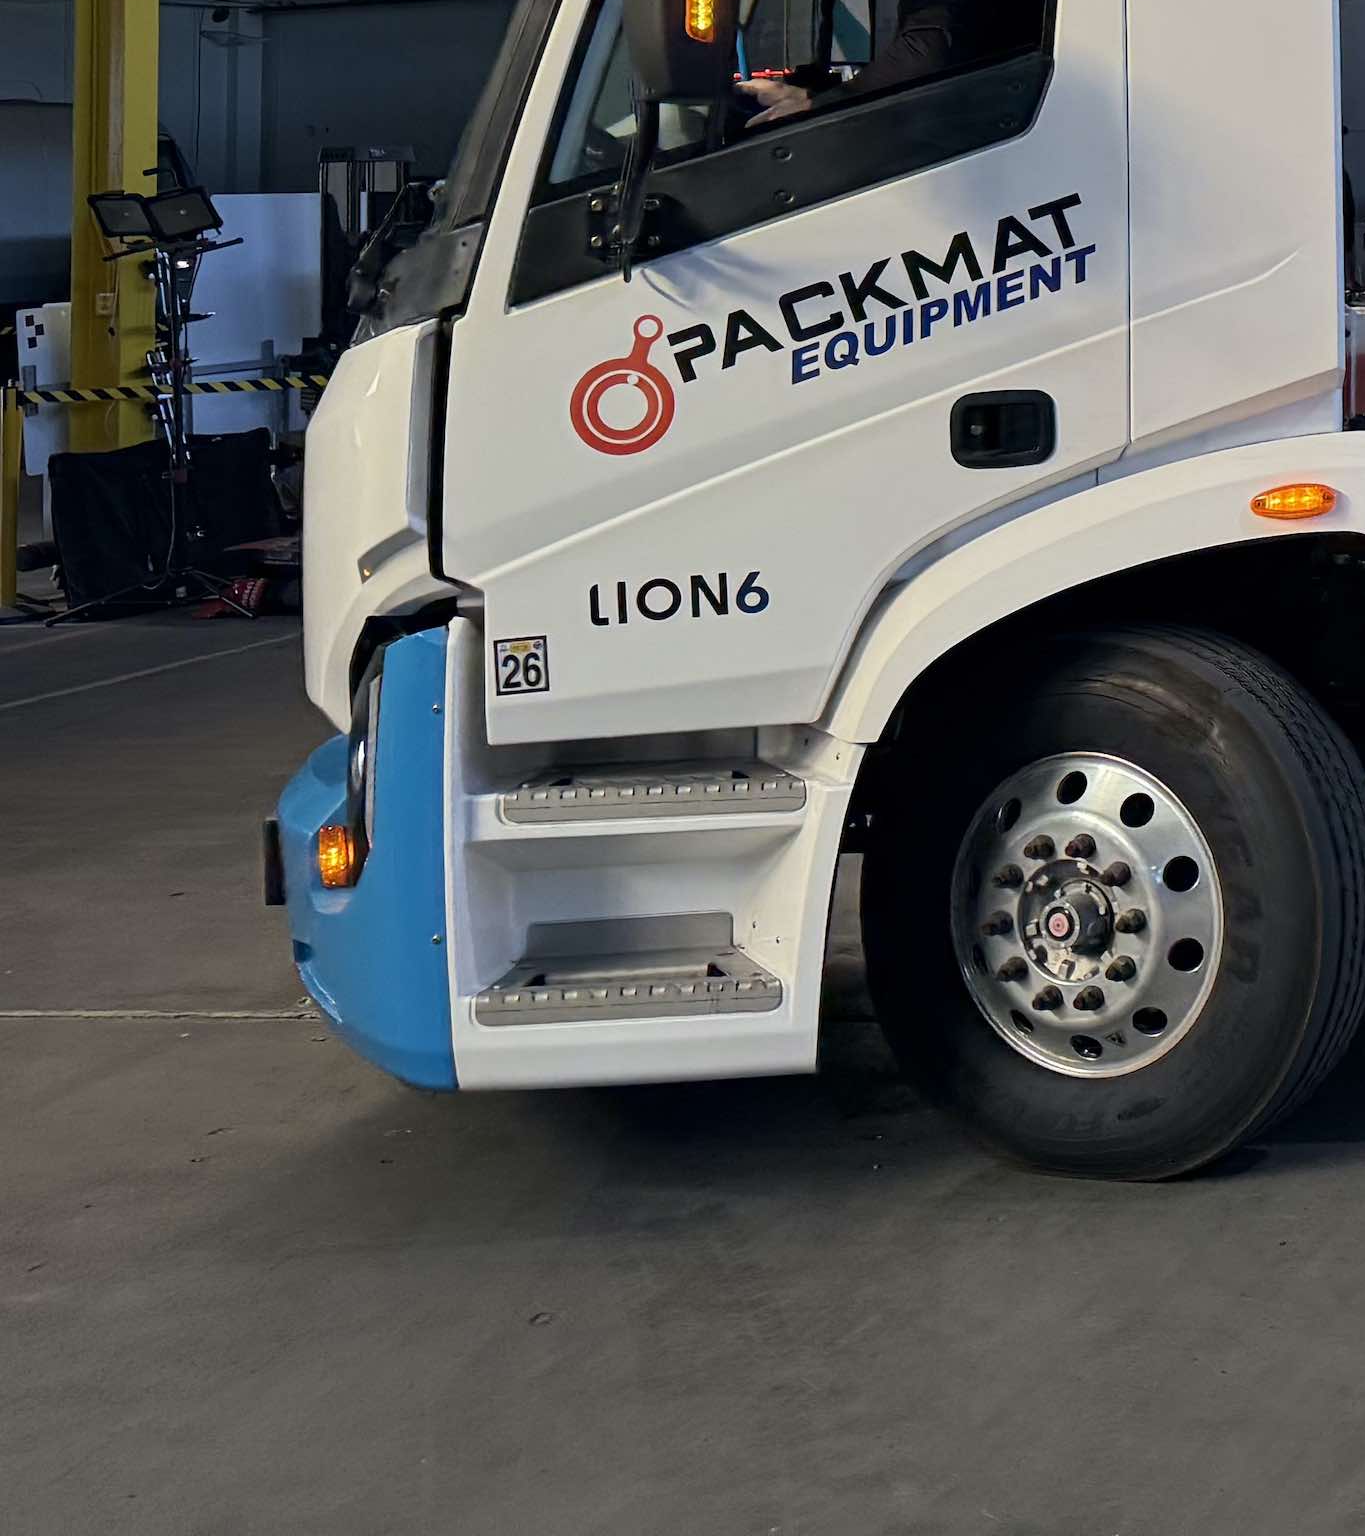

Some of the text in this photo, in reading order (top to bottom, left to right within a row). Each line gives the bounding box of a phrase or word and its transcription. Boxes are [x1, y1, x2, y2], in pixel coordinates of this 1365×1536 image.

[667, 193, 1081, 383] PACKMAT
[791, 244, 1096, 385] EQUIPMENT
[589, 571, 769, 626] LION6
[501, 652, 542, 689] 26
